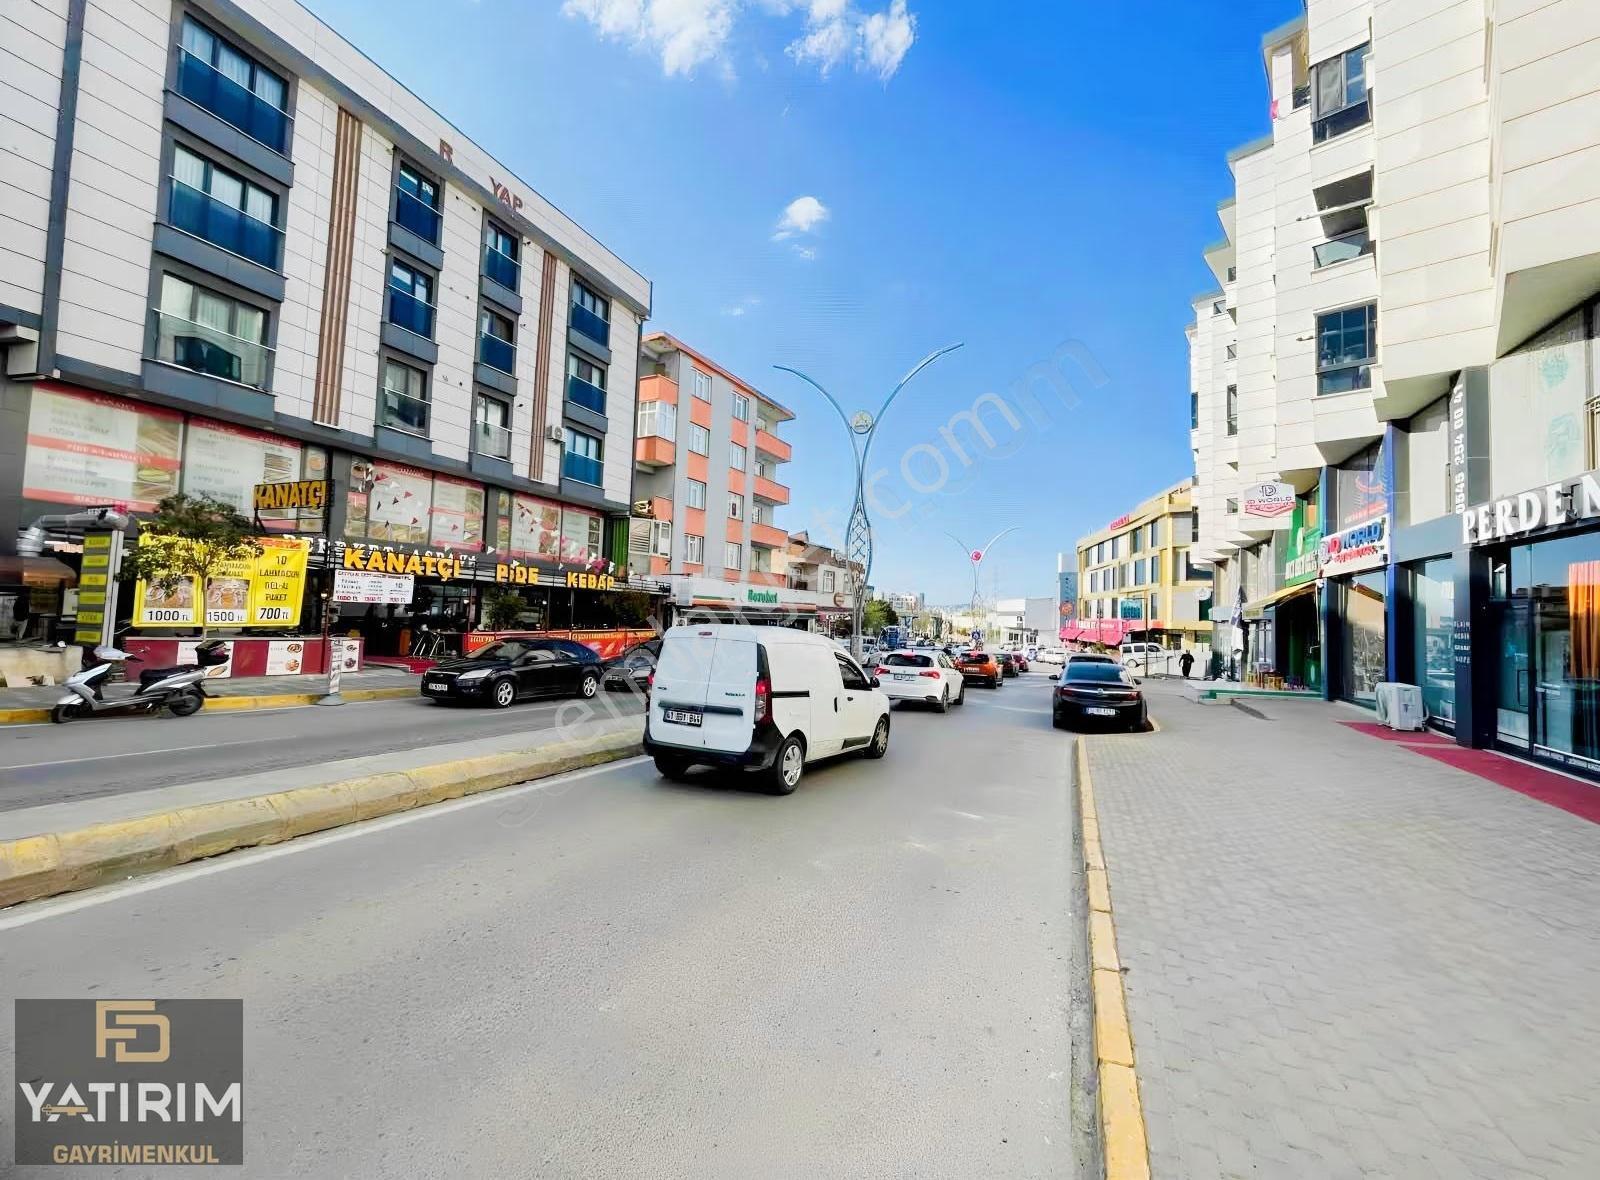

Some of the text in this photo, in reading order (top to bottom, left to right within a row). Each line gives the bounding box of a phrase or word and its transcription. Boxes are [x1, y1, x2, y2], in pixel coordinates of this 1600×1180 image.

[1454, 433, 1464, 465] 254
[253, 481, 327, 510] KANATÇI
[1462, 483, 1566, 545] PERDE
[344, 548, 461, 581] KANATÇI
[567, 571, 615, 590] KEBAP
[148, 610, 180, 621] 1000
[207, 611, 234, 621] 1500
[259, 607, 282, 620] 700
